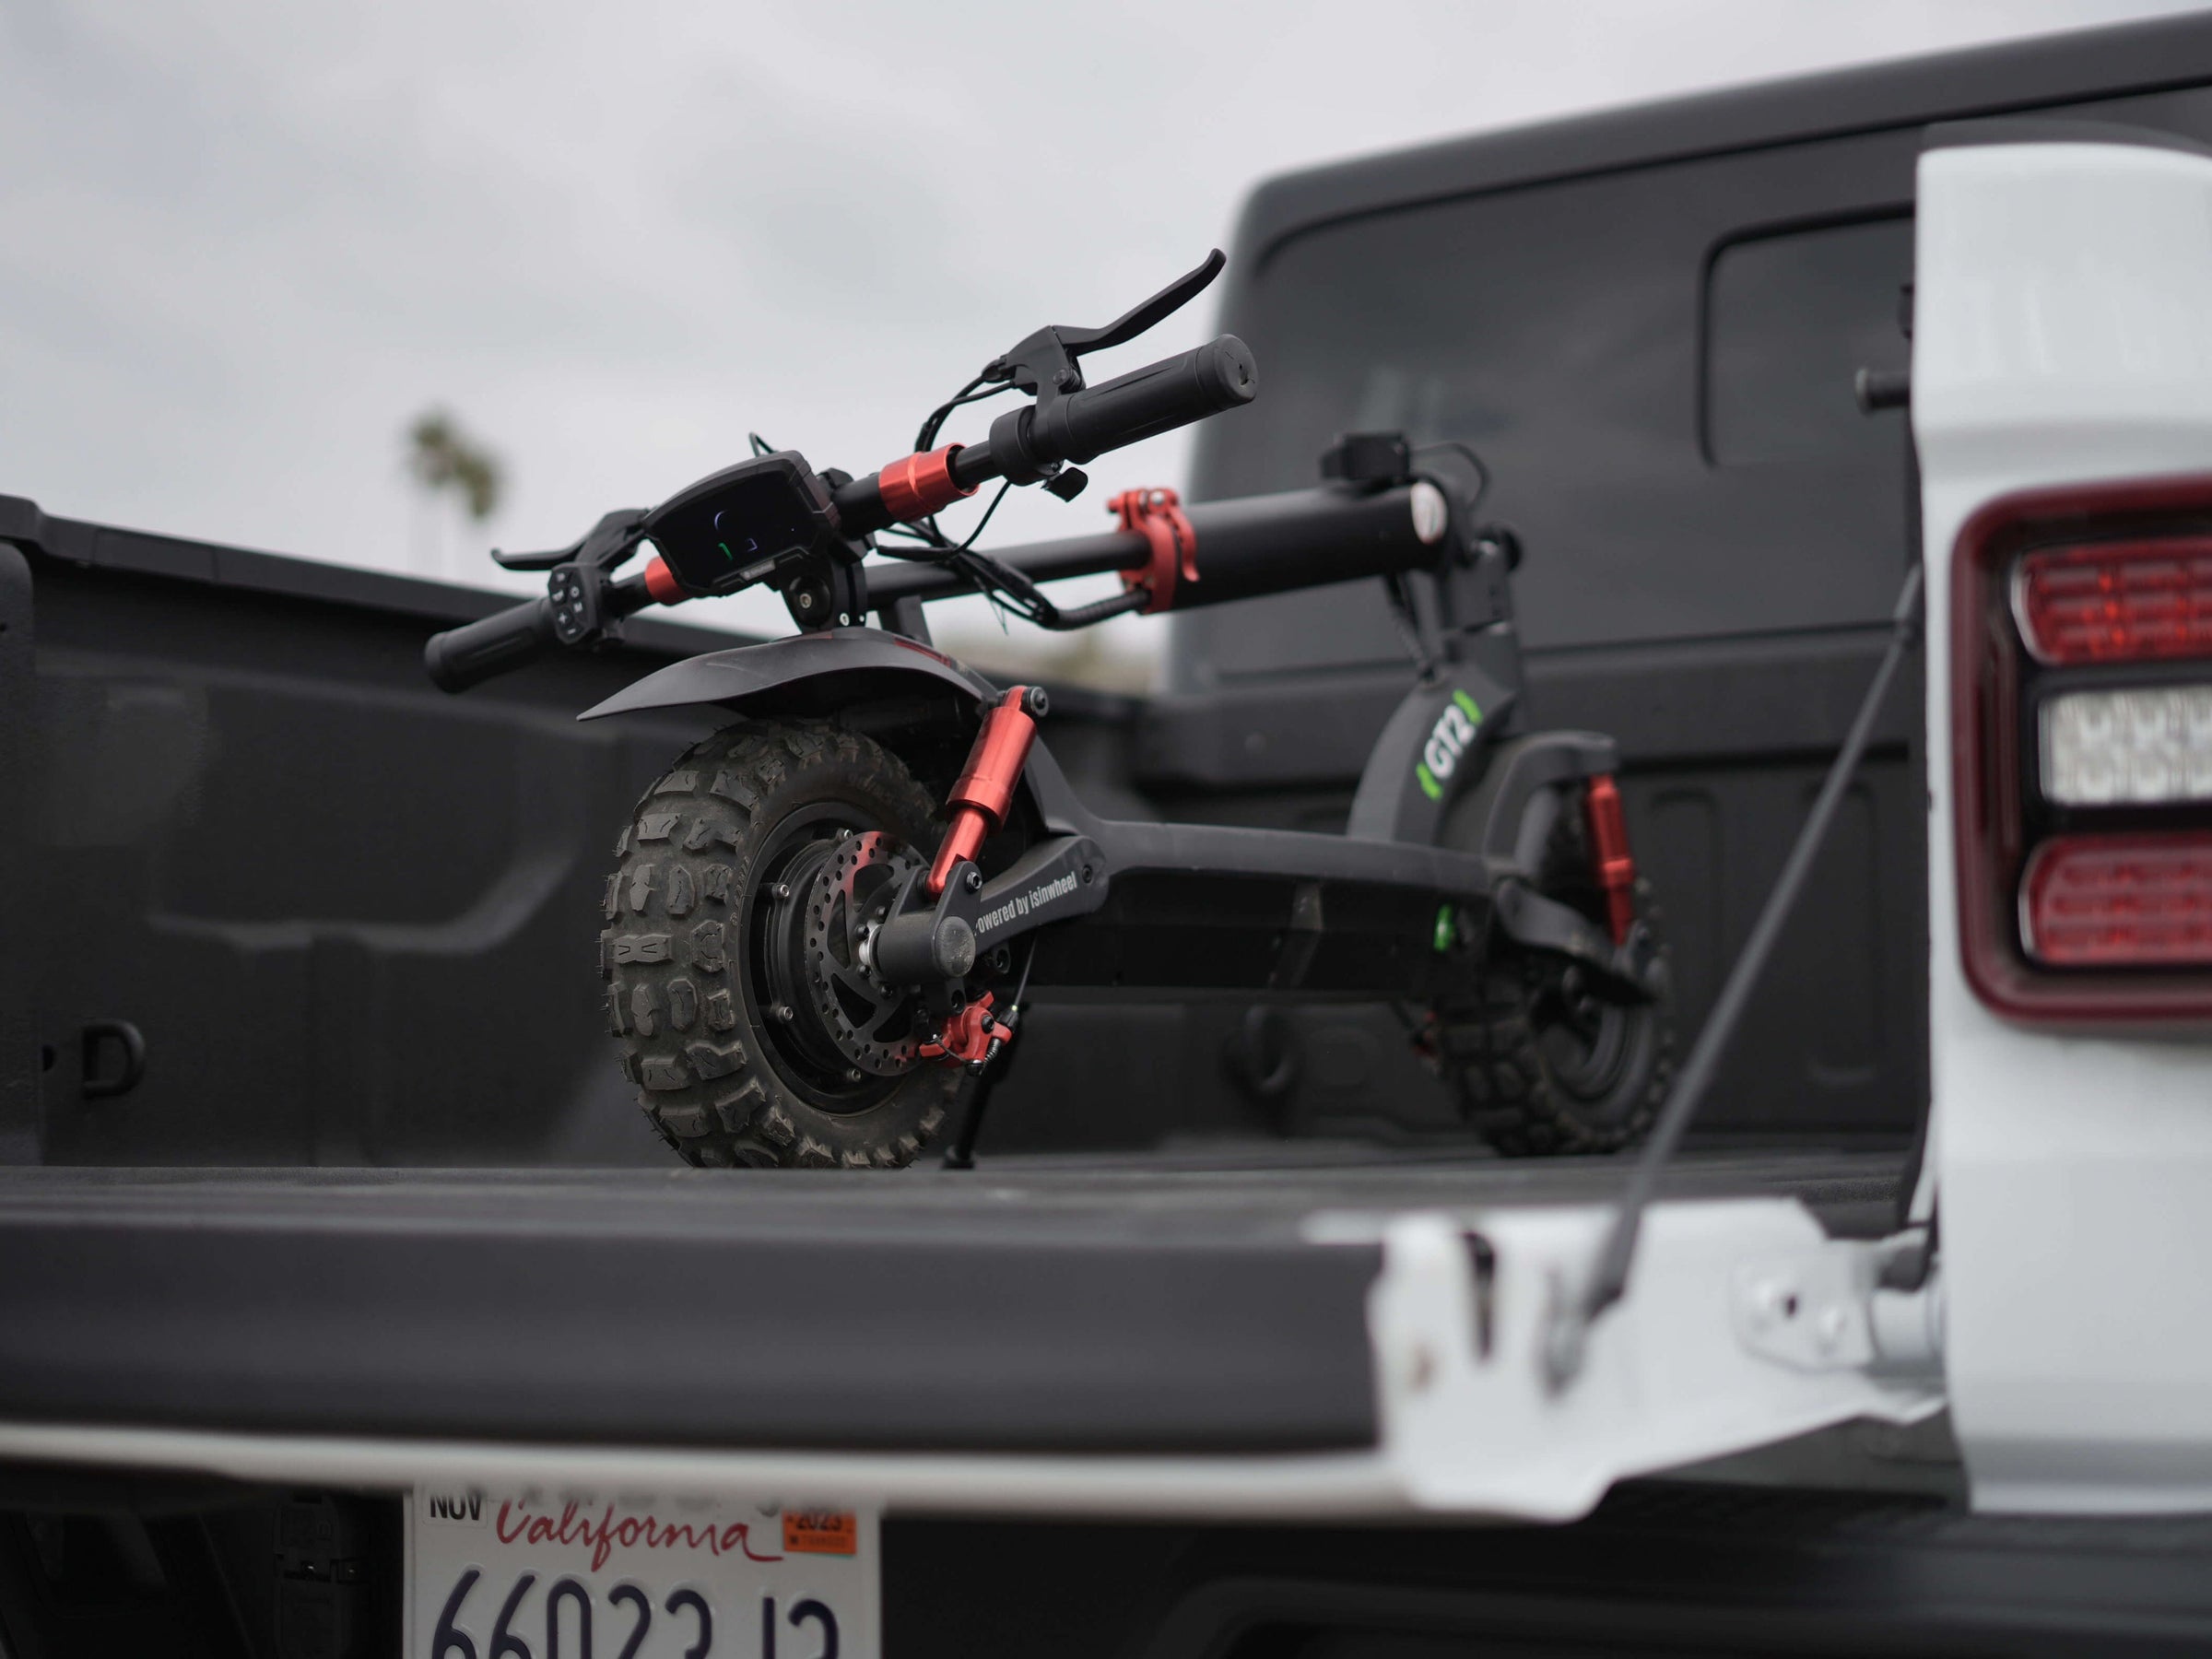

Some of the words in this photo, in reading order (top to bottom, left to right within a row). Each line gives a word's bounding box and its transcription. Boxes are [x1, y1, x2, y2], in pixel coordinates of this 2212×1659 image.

[1424, 704, 1476, 779] GT2
[973, 899, 1017, 936] owered
[1016, 895, 1030, 915] by
[1029, 870, 1077, 909] isinwheel
[429, 1495, 482, 1521] NOV
[496, 1499, 783, 1572] California
